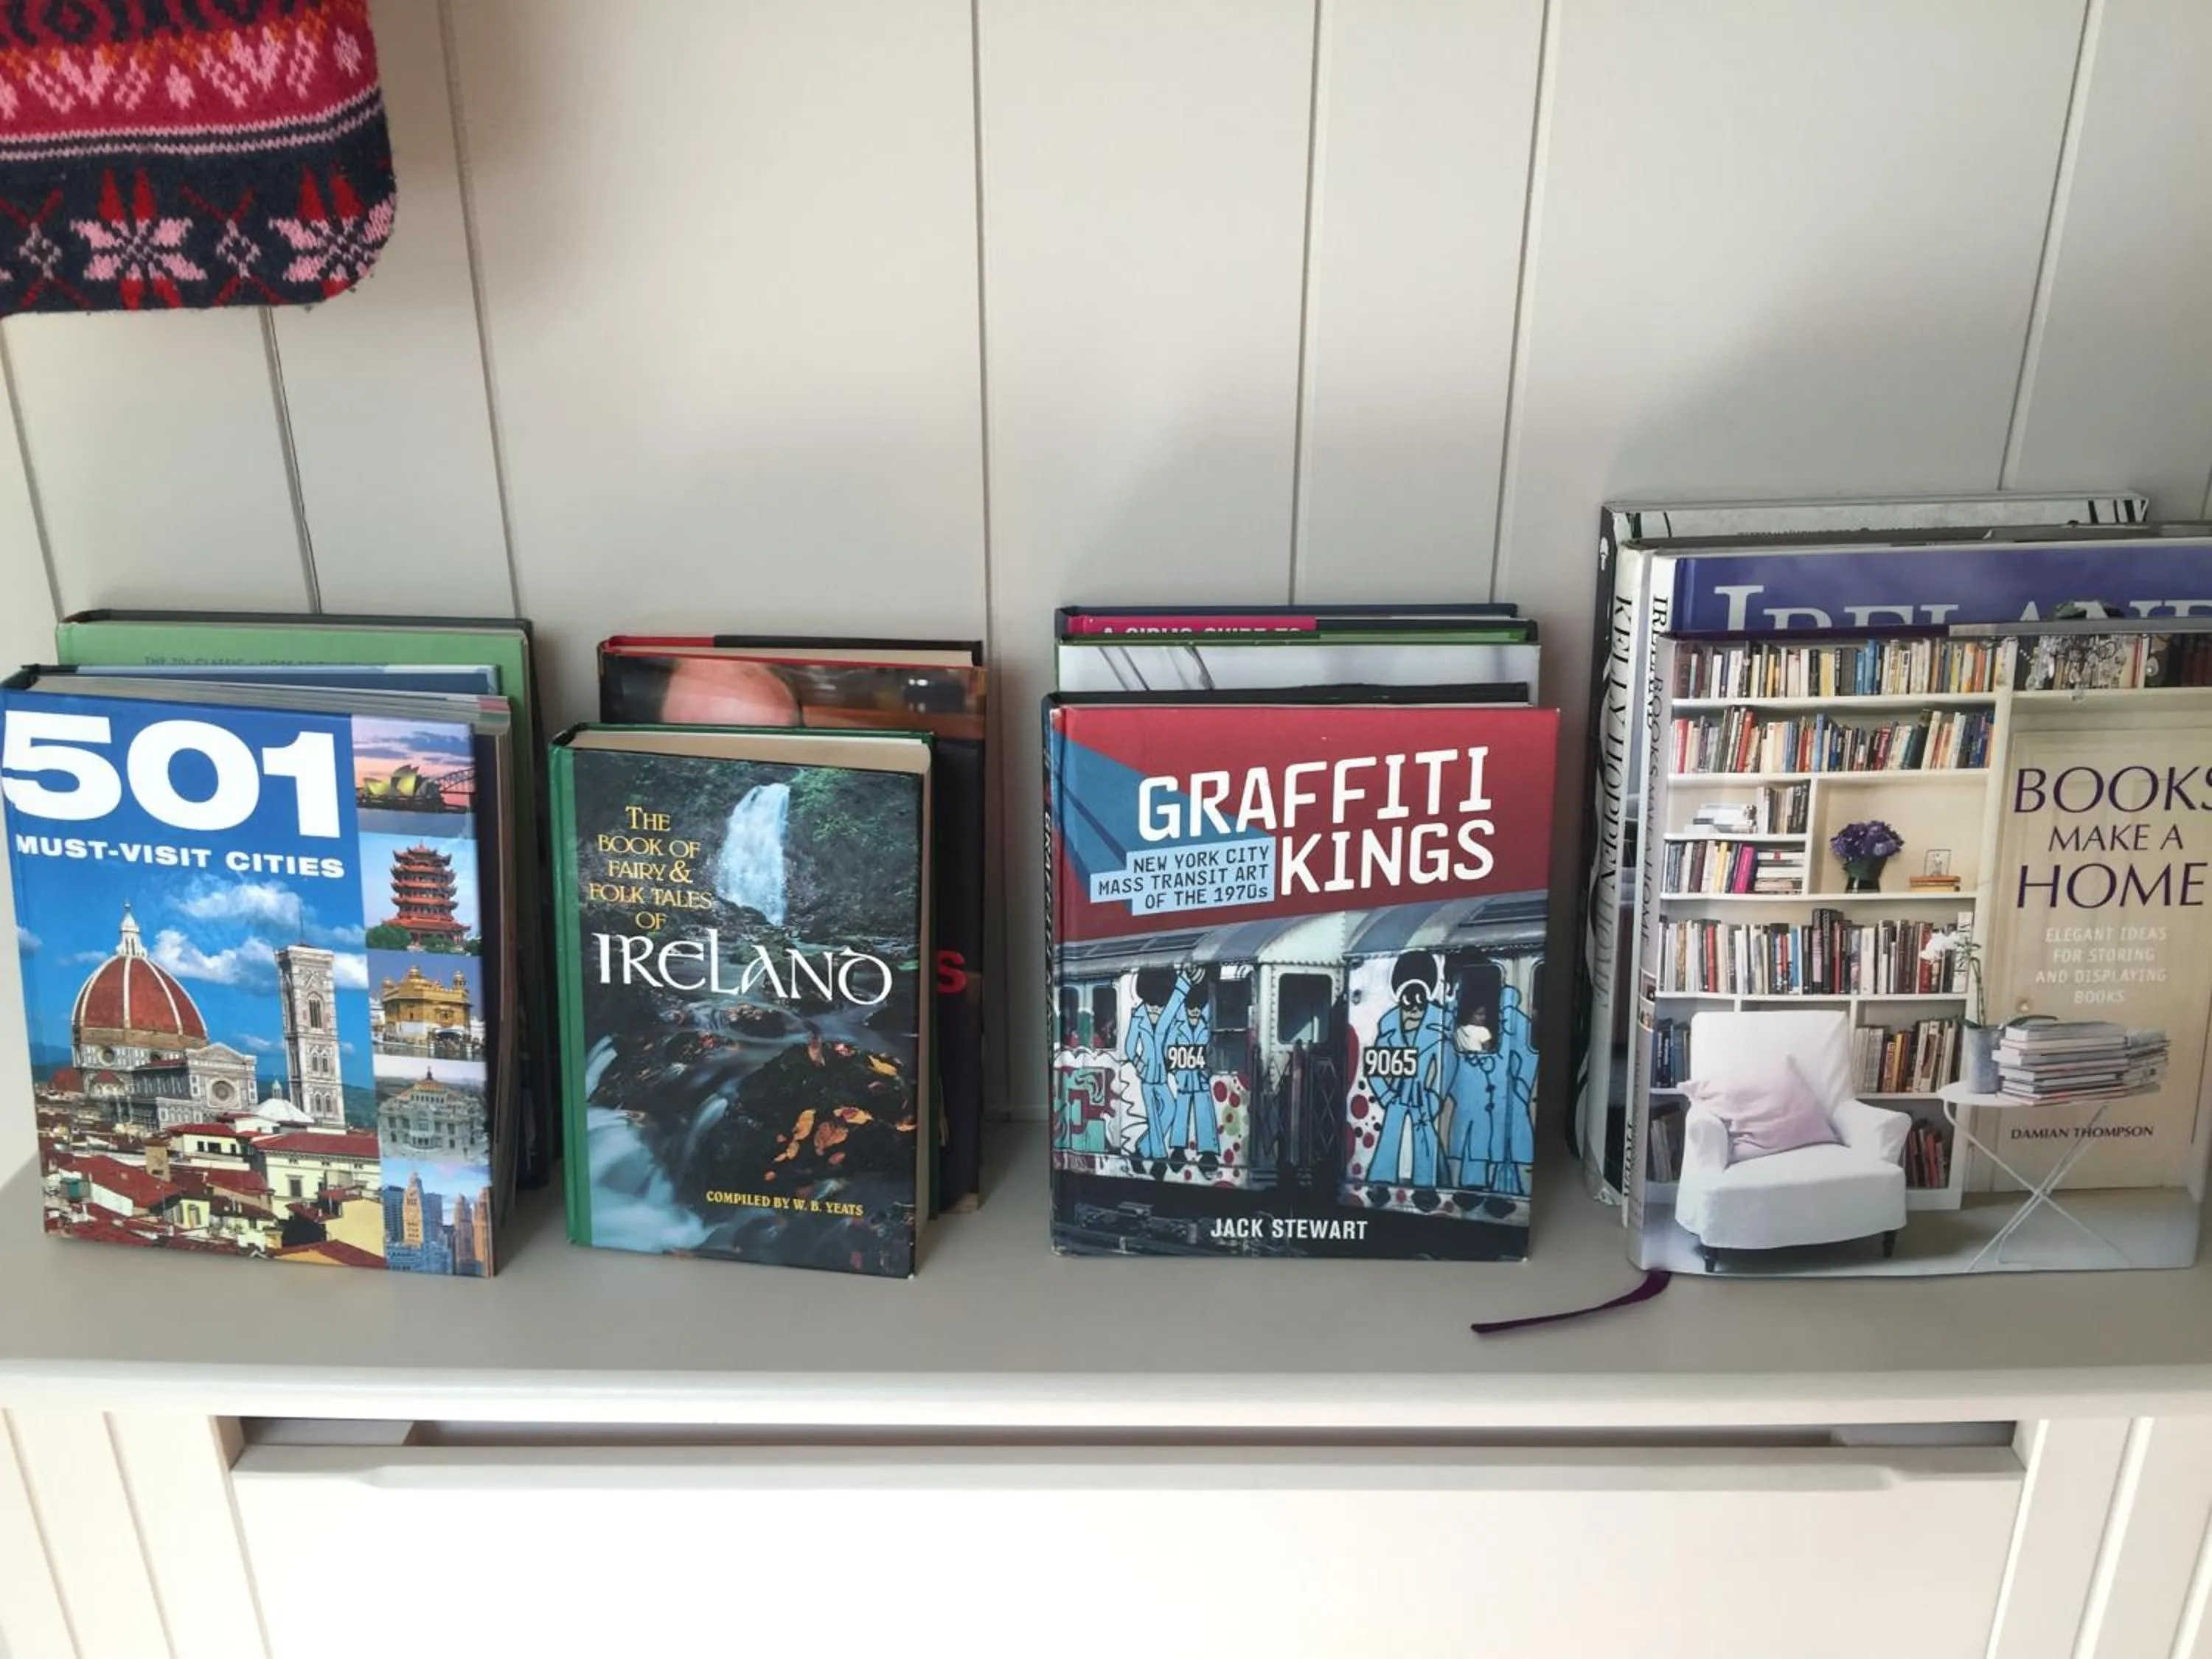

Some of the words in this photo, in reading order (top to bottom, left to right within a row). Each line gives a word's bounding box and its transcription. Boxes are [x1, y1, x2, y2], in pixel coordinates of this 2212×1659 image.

[1607, 595, 1632, 727] KELLY
[1649, 677, 1664, 776] BOOKS
[1, 710, 341, 838] 501
[1138, 746, 1492, 842] GRAFFITI
[625, 805, 671, 832] THE
[597, 834, 664, 856] BOOK
[669, 839, 701, 859] OF
[2048, 824, 2151, 852] MAKE
[2160, 824, 2184, 850] A
[15, 834, 212, 869] MUST-VISIT
[226, 851, 345, 878] CITIES
[1133, 855, 1168, 874] NEW
[1174, 849, 1220, 869] YORK
[1225, 845, 1270, 864] CITY
[1280, 819, 1495, 896] KINGS
[607, 860, 667, 881] FAIRY
[669, 860, 694, 884] &
[1098, 877, 1144, 896] MASS
[1150, 868, 1229, 890] TRANSIT
[1234, 863, 1269, 882] ART
[2017, 862, 2208, 909] HOME
[589, 883, 644, 904] FOLK
[650, 887, 713, 910] TALES
[1144, 892, 1167, 910] OF
[1173, 888, 1208, 906] THE
[1213, 884, 1268, 902] 1970s
[635, 911, 669, 931] OF
[2045, 927, 2115, 943] ELEGANT
[2120, 926, 2168, 942] IDEAS
[592, 928, 893, 1005] IRELAND
[2053, 948, 2083, 963] FOR
[2087, 947, 2155, 963] STORING
[2035, 970, 2067, 984] AND
[2074, 967, 2167, 984] DISPLAYING
[2073, 990, 2125, 1004] BOOKS
[1167, 1046, 1206, 1069] 9064
[1365, 1049, 1417, 1076] 9065
[2010, 1127, 2069, 1140] DAMIAN
[2073, 1125, 2154, 1139] THOMPSON
[706, 1190, 771, 1208] COMPILED
[773, 1197, 790, 1210] BY
[792, 1198, 807, 1211] W.
[810, 1200, 822, 1212] B.
[825, 1201, 864, 1217] YEATS
[1210, 1218, 1264, 1239] JACK
[1272, 1219, 1368, 1240] STEWART
